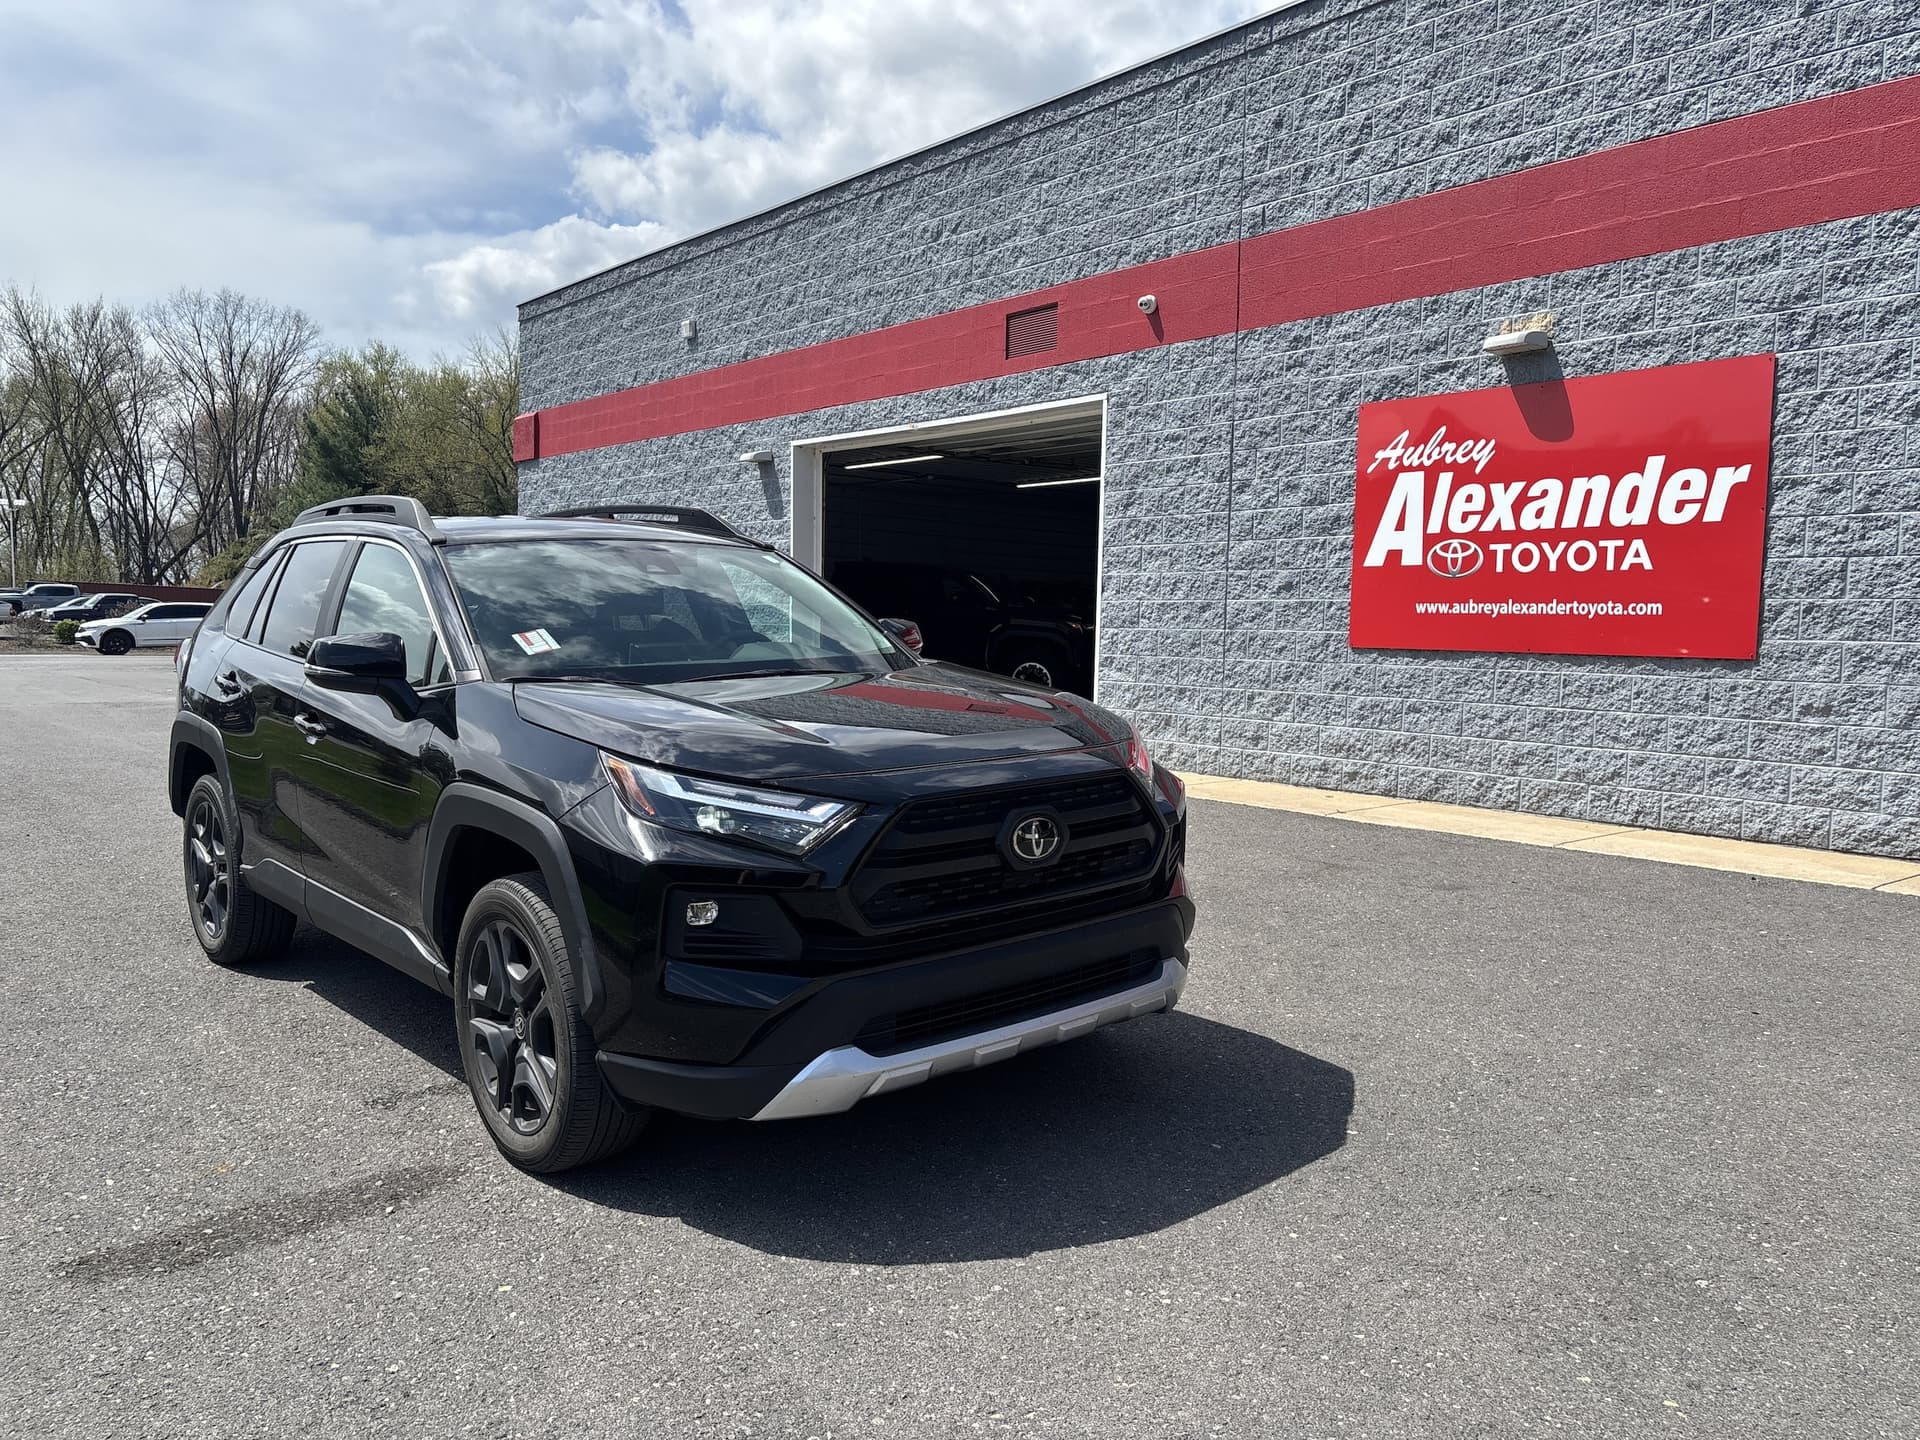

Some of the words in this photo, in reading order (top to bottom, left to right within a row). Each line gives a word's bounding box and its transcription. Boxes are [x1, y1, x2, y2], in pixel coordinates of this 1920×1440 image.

[1367, 425, 1496, 474] Aubrey
[1363, 455, 1752, 567] Alexander
[1489, 539, 1654, 573] TOYOTA
[1415, 599, 1663, 619] www.aubreyalexandertoyota.com
